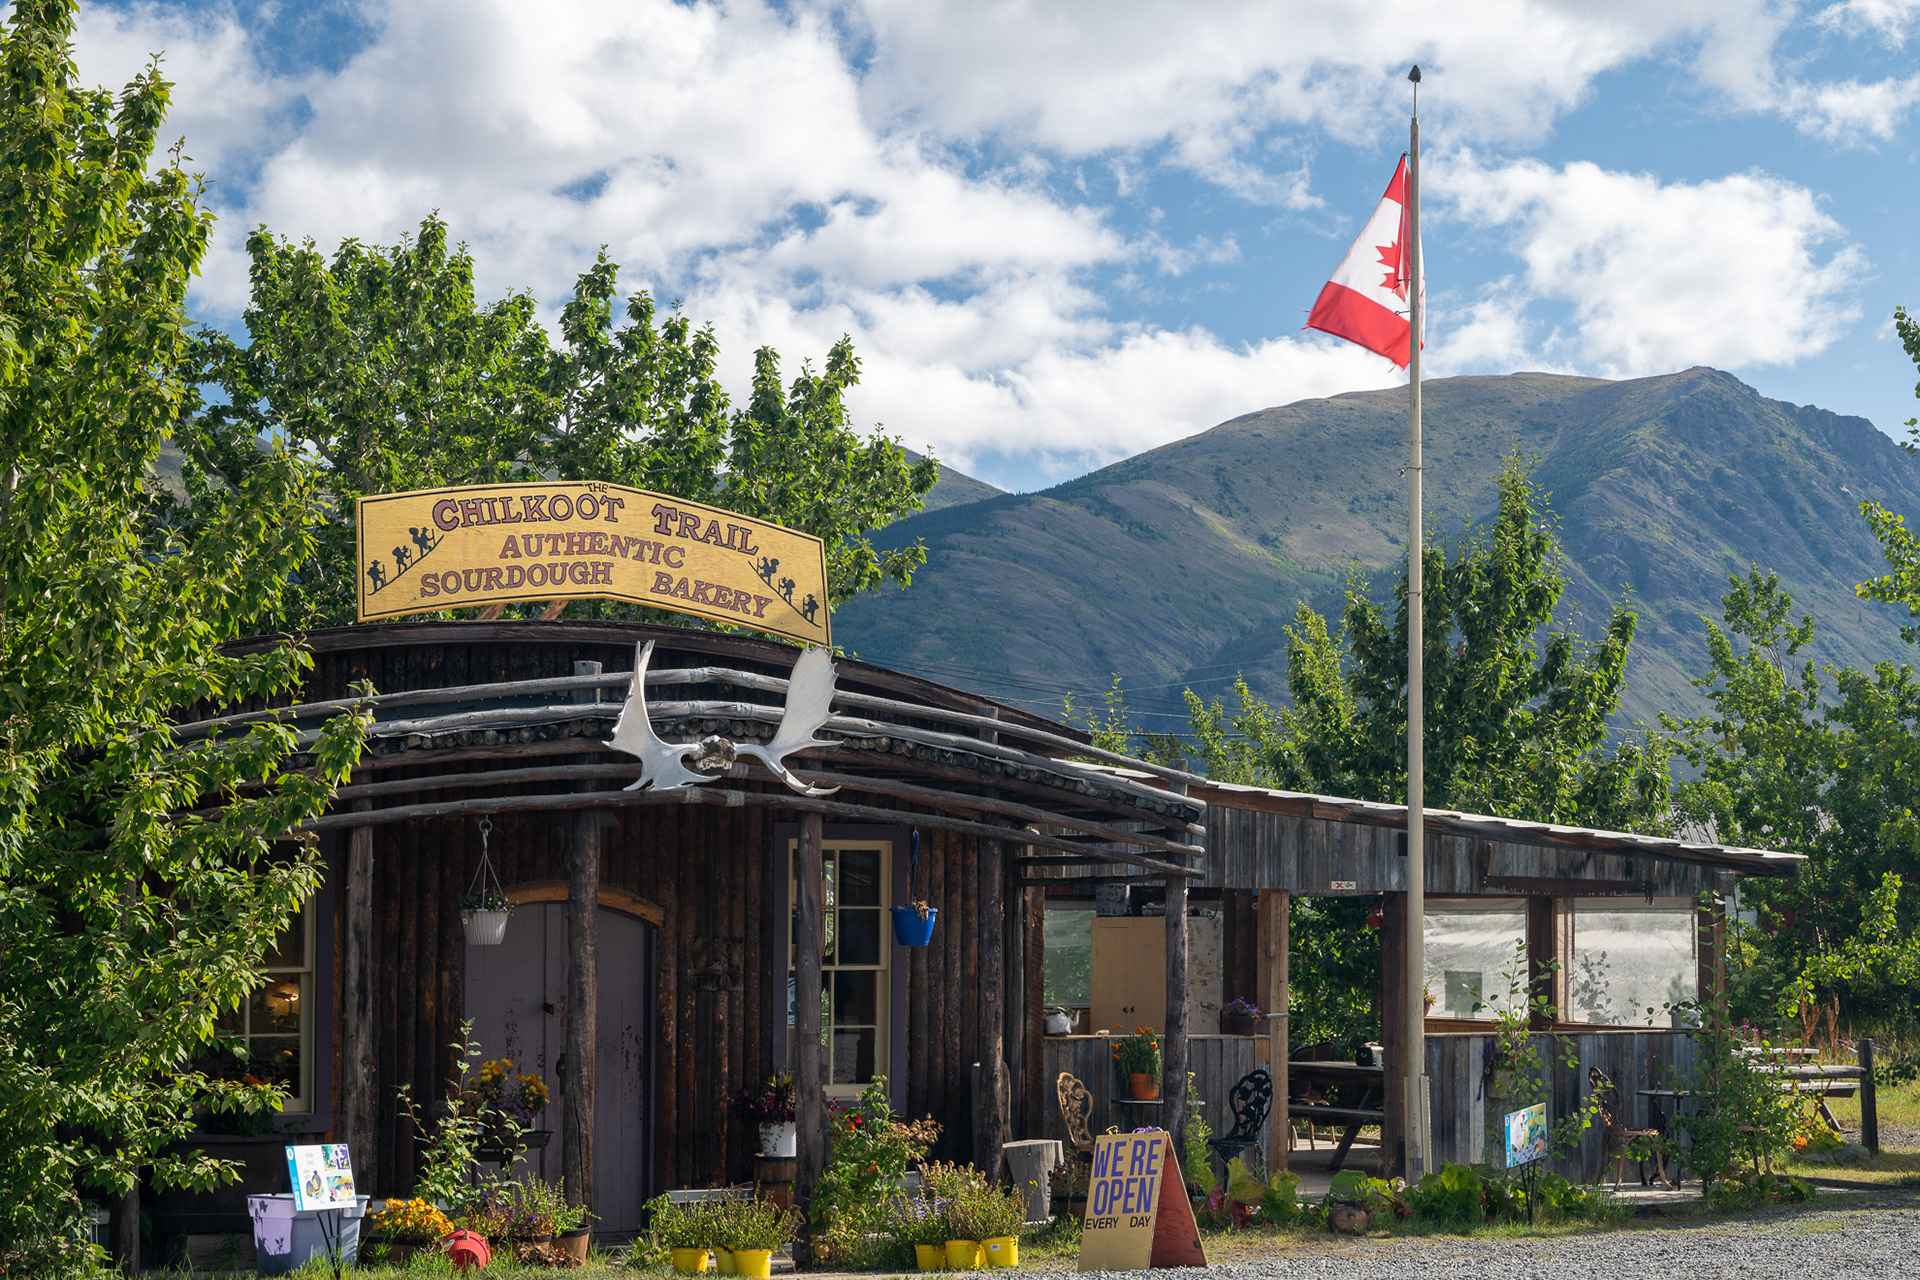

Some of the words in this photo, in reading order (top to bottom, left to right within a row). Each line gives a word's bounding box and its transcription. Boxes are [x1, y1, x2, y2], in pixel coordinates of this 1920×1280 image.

[585, 483, 610, 494] THE
[432, 493, 625, 531] CHILKOOT
[652, 503, 759, 556] TRAIL
[499, 532, 685, 568] AUTHENTIC
[420, 561, 614, 598] SOURDOUGH
[650, 571, 773, 618] BAKERY
[1093, 1138, 1162, 1178] WE'RE
[1093, 1177, 1155, 1216] OPEN
[1085, 1217, 1119, 1230] EVERY
[1129, 1216, 1151, 1228] DAY
